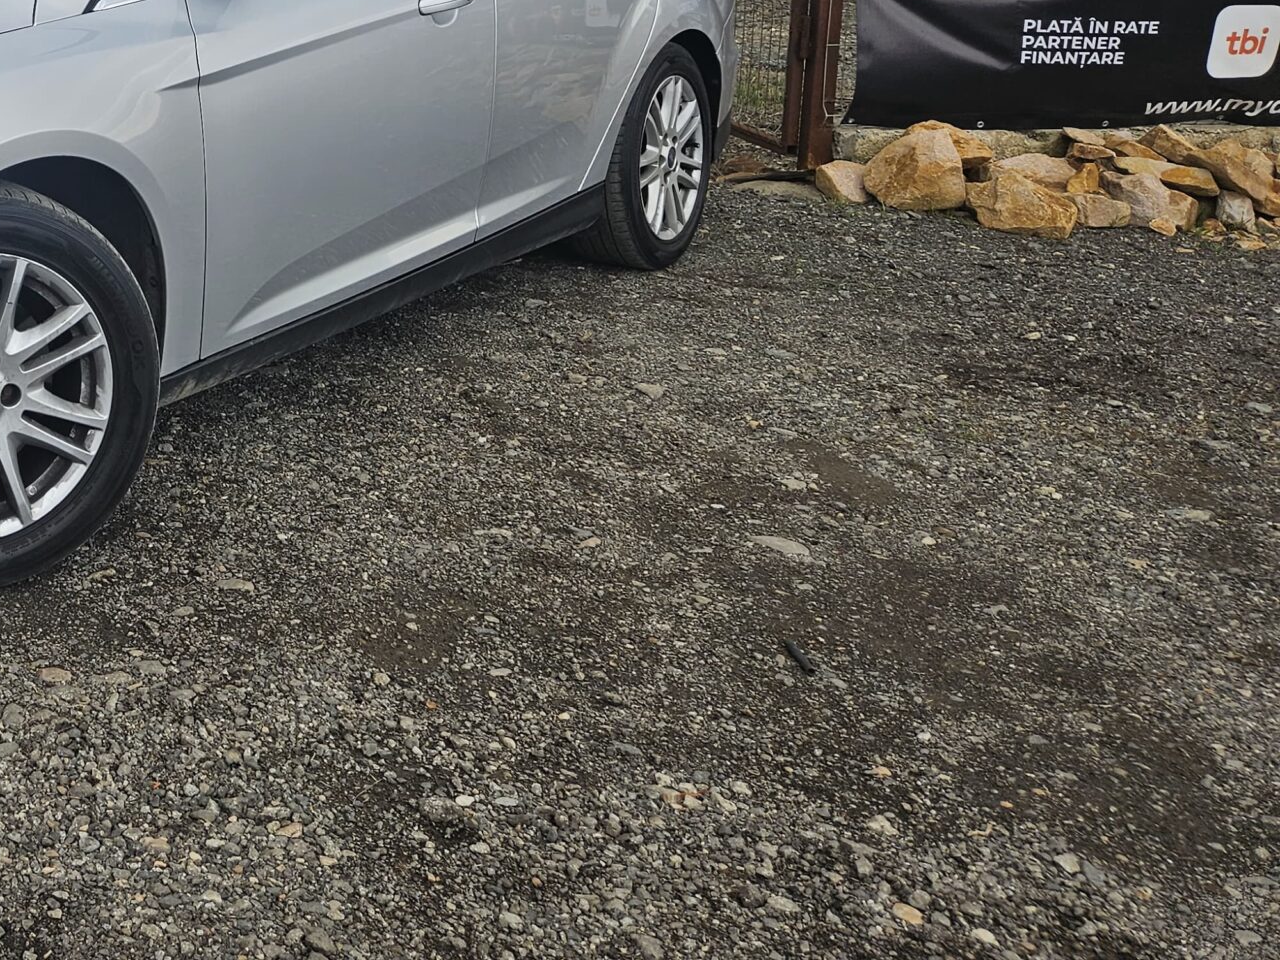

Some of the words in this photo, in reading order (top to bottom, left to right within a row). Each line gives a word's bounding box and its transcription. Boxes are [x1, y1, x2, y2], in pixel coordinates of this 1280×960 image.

[1022, 17, 1084, 34] PLATĂ
[1088, 17, 1109, 34] ÎN
[1113, 20, 1160, 34] RATE
[1021, 35, 1121, 50] PARTENER
[1226, 26, 1270, 55] tbi
[1020, 50, 1125, 68] FINANȚARE
